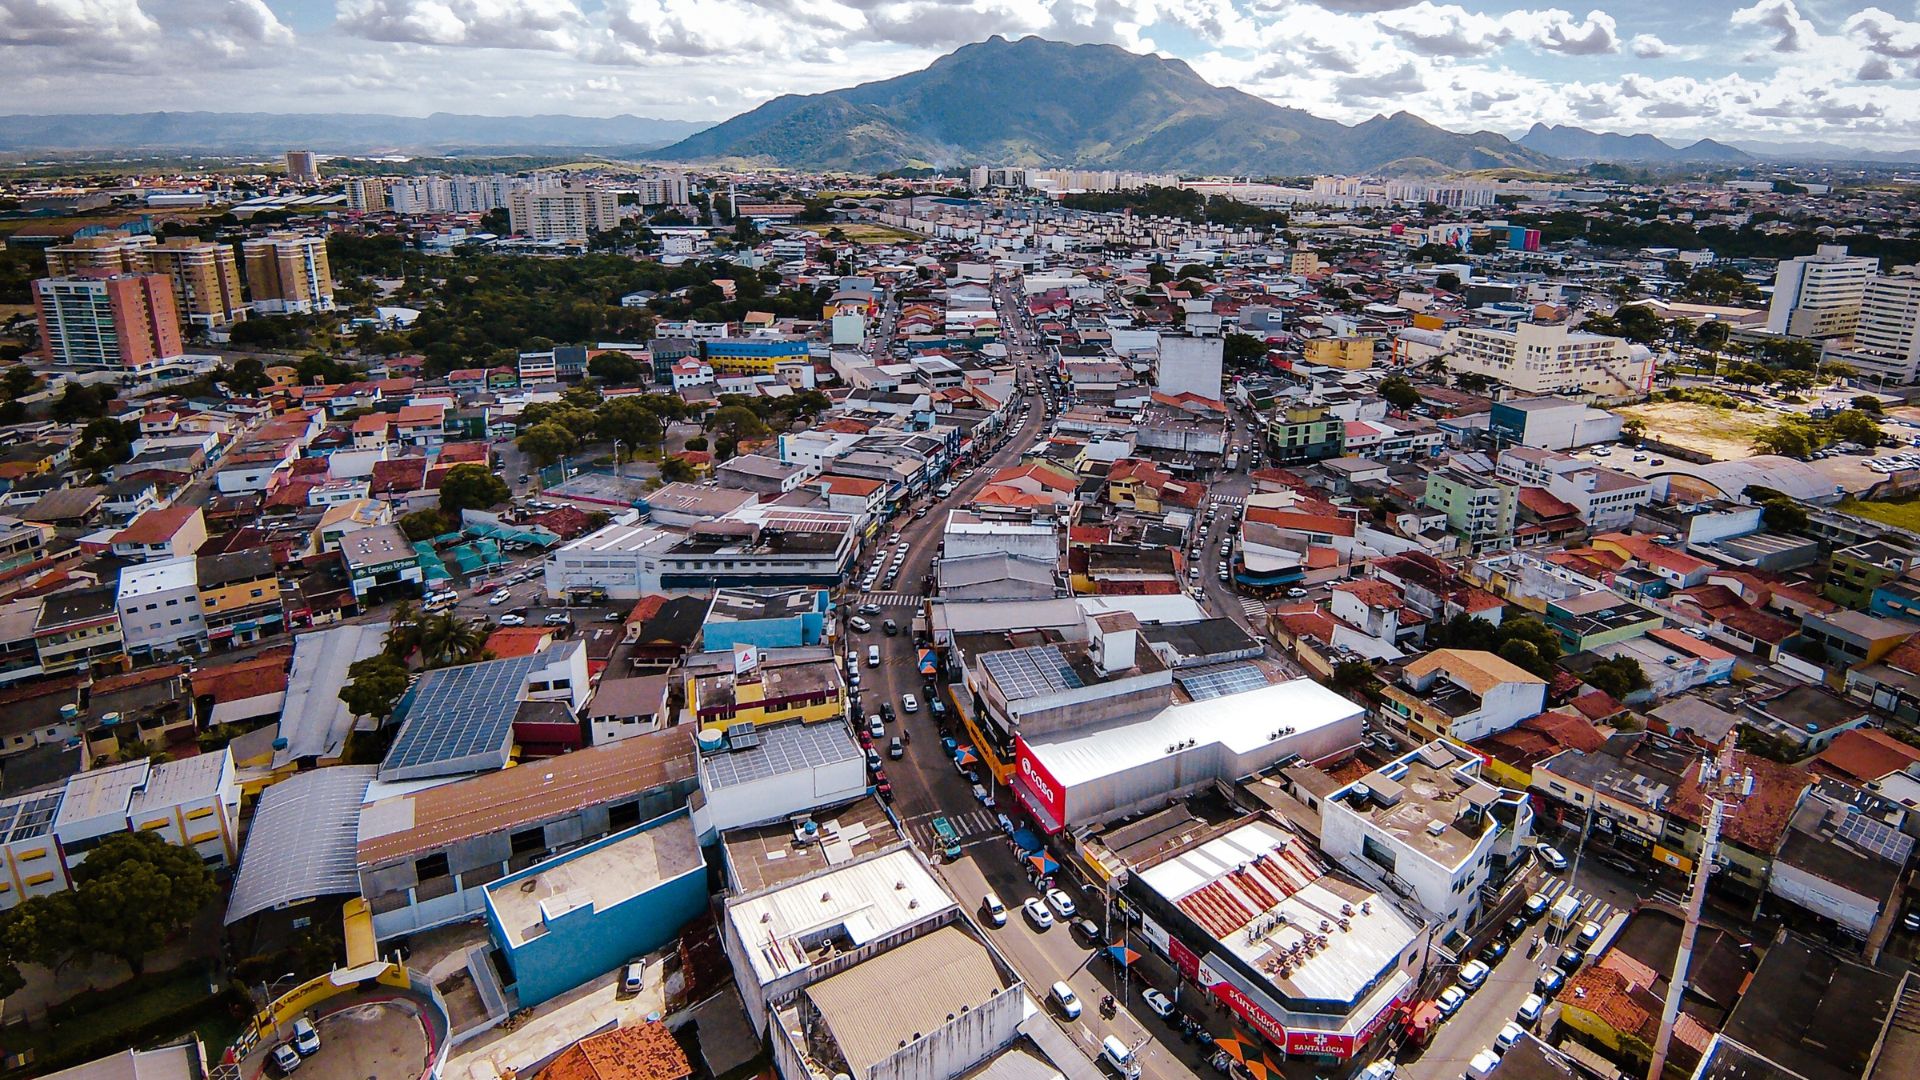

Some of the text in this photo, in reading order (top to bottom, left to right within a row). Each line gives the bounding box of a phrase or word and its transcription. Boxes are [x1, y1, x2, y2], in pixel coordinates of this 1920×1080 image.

[1030, 770, 1054, 803] casa
[1229, 990, 1256, 1016] SANTA
[1294, 1044, 1320, 1052] SANTA
